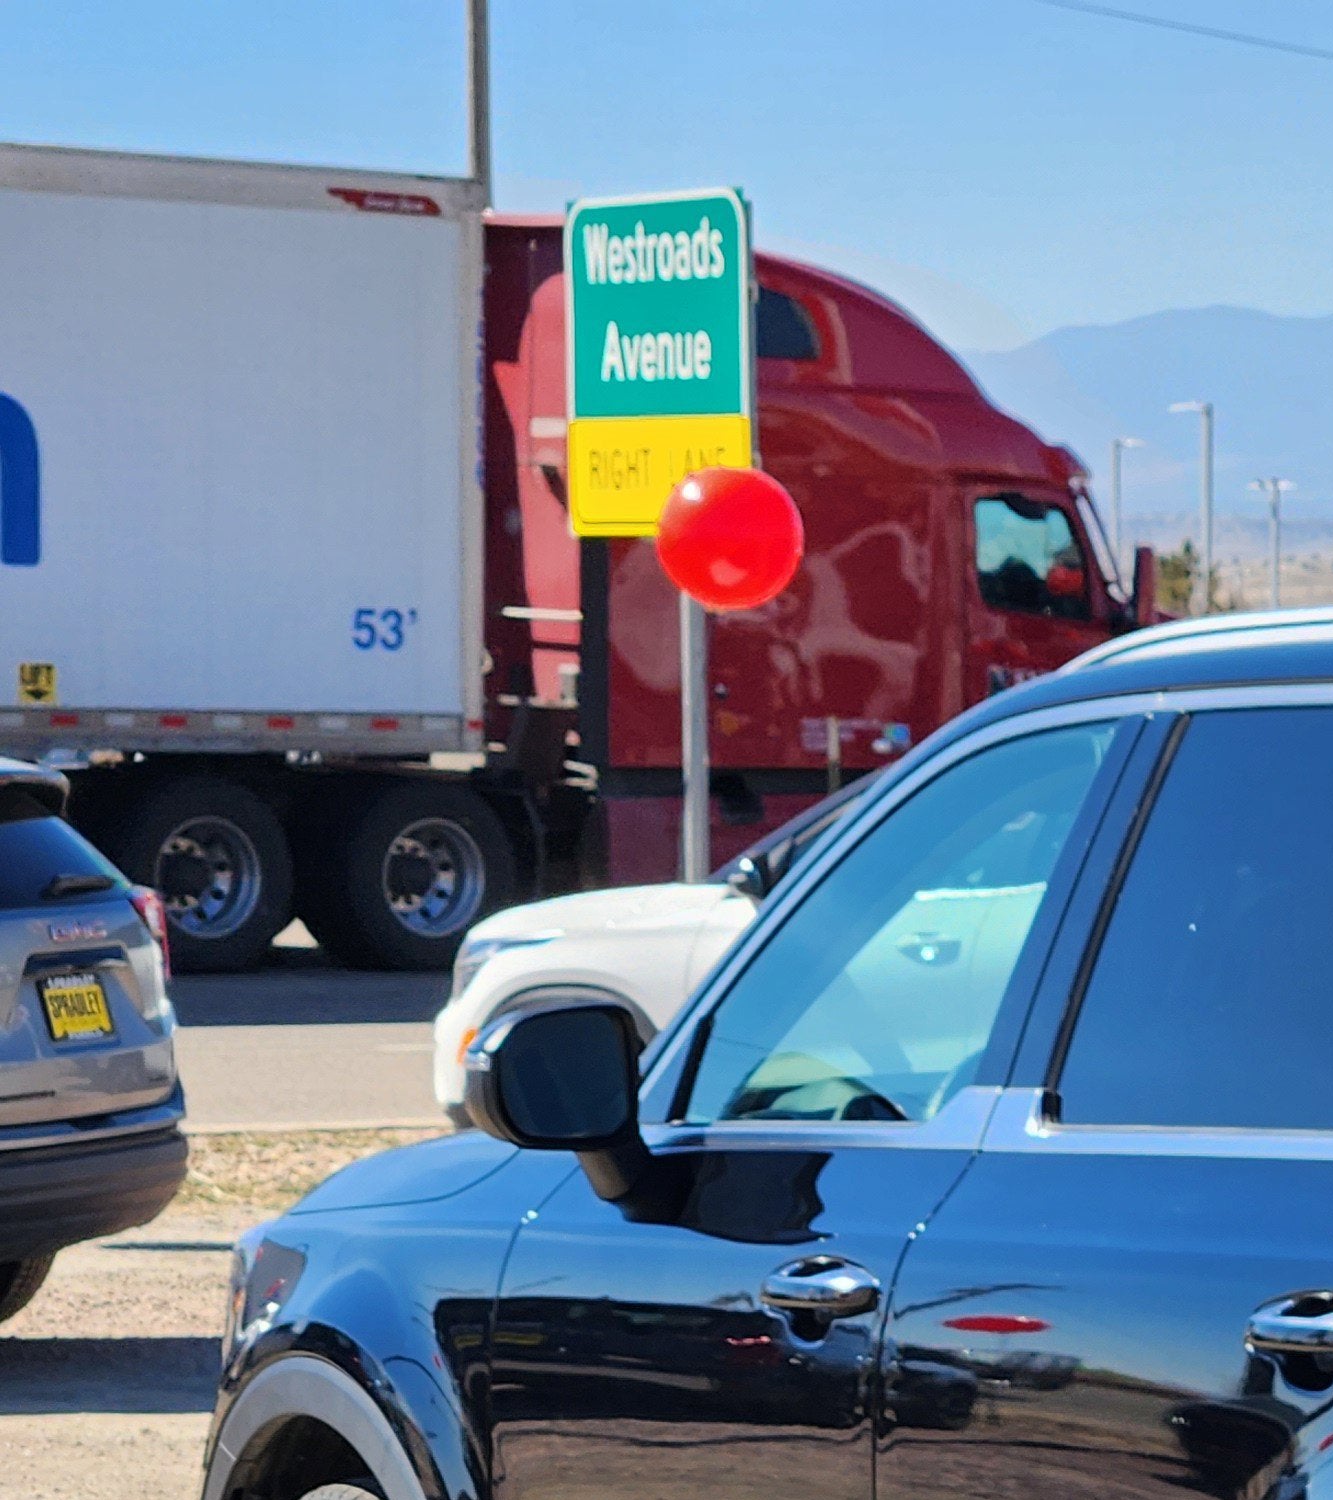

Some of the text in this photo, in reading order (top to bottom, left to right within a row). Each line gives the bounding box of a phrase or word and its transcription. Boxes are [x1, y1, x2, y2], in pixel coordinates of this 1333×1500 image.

[583, 216, 725, 285] Westroads
[601, 320, 712, 382] Avenue
[589, 448, 652, 490] RIGHT
[352, 608, 418, 651] 53'
